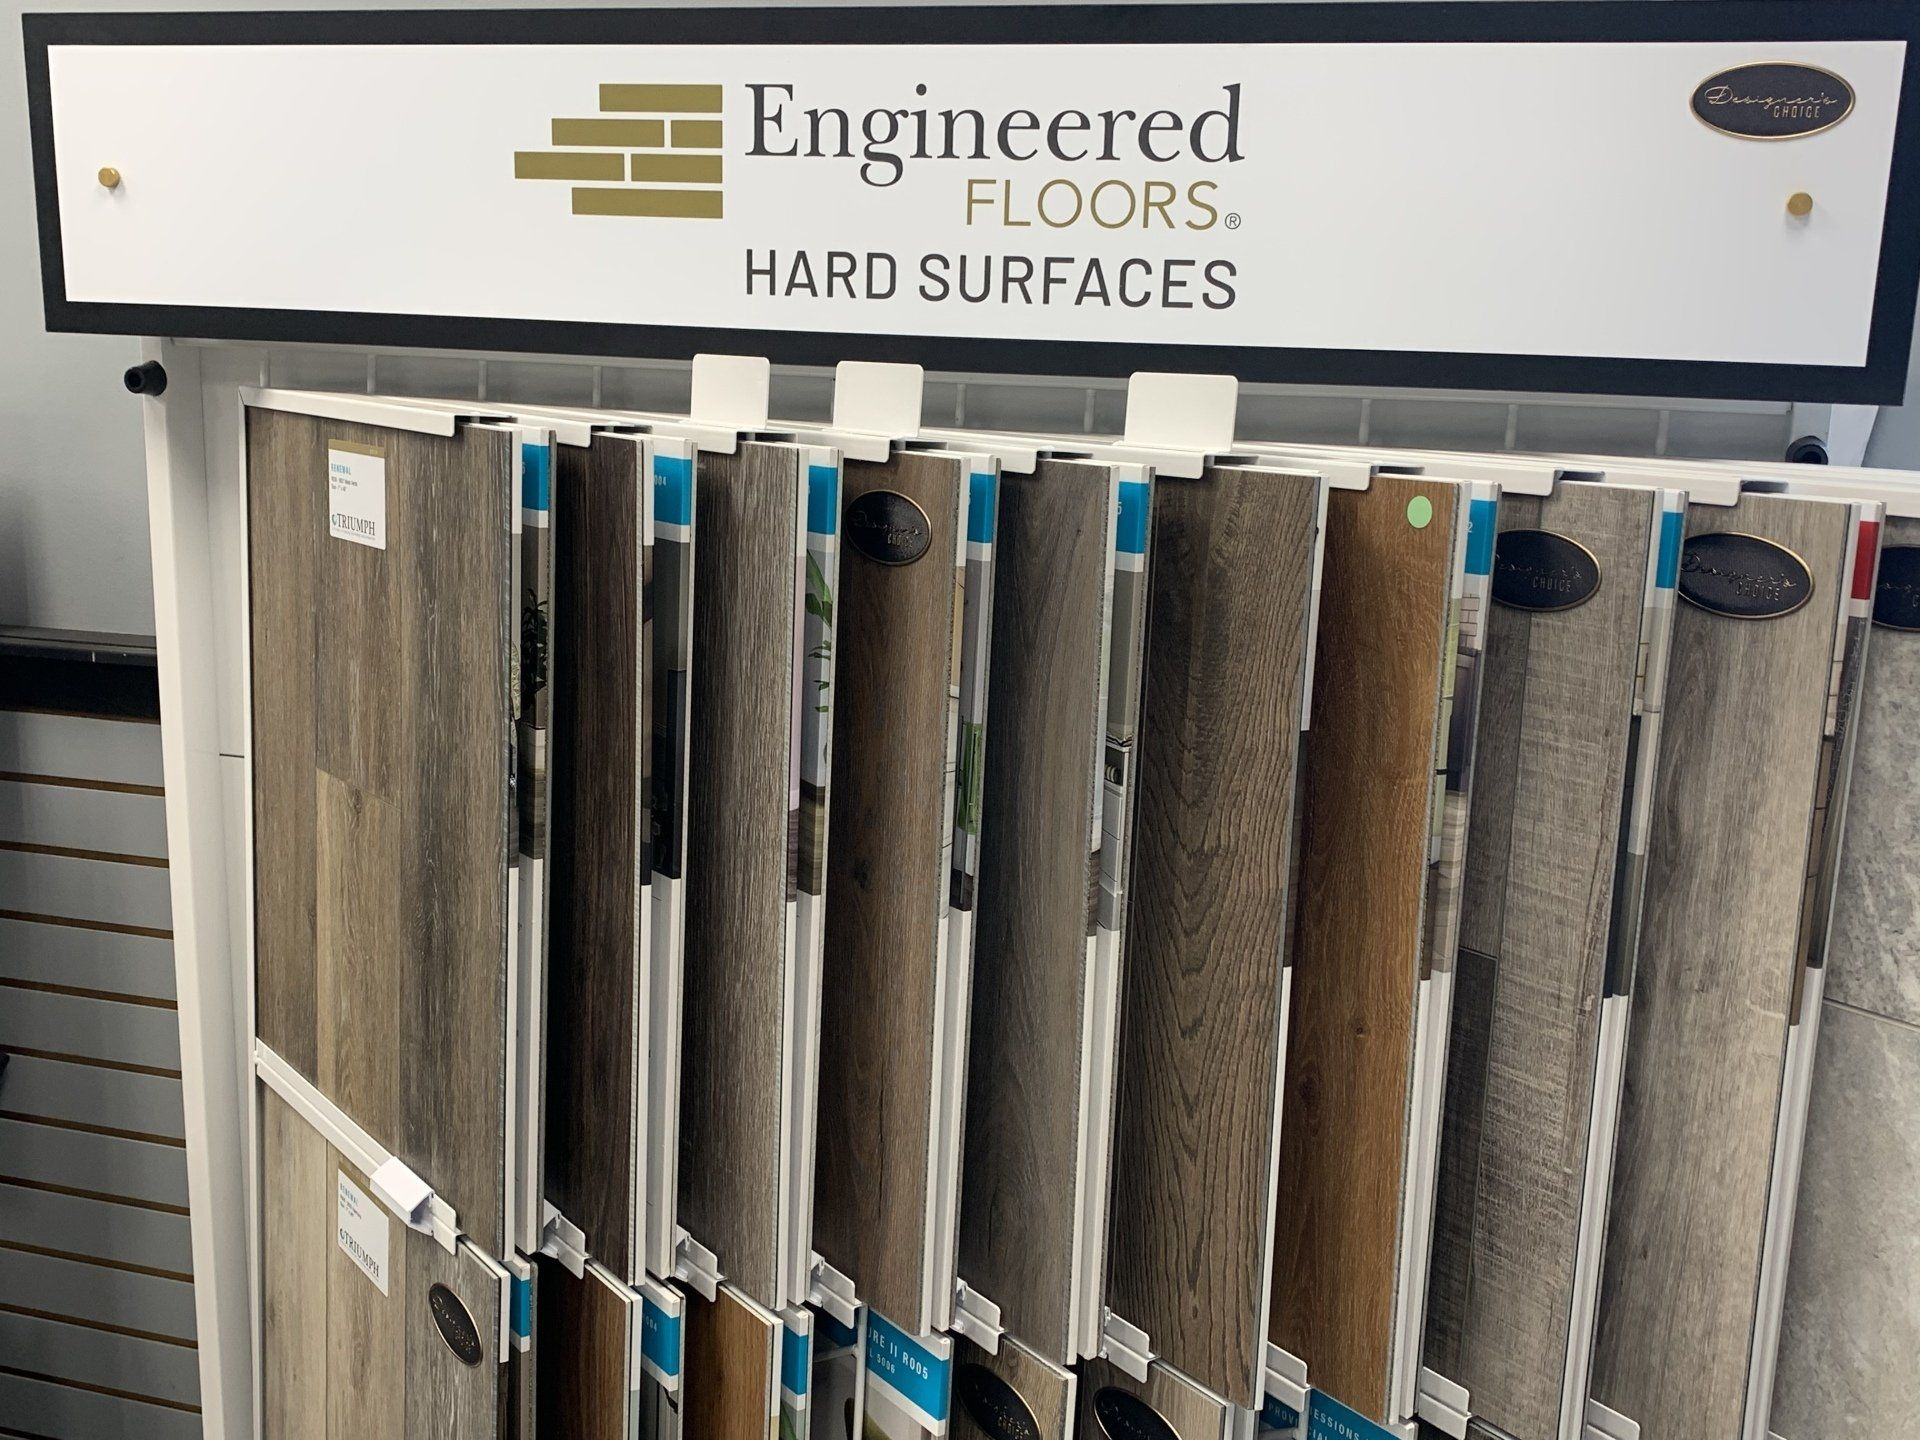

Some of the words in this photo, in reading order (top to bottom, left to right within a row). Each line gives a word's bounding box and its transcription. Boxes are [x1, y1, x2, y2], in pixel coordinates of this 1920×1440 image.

[1704, 85, 1838, 109] Designer's
[1773, 105, 1820, 119] CHOICE
[745, 83, 1245, 187] Engineered
[966, 179, 1219, 230] FLOORS
[745, 248, 897, 300] HARD
[918, 253, 1238, 310] SURFACES
[1310, 1406, 1361, 1440] ESSIONS
